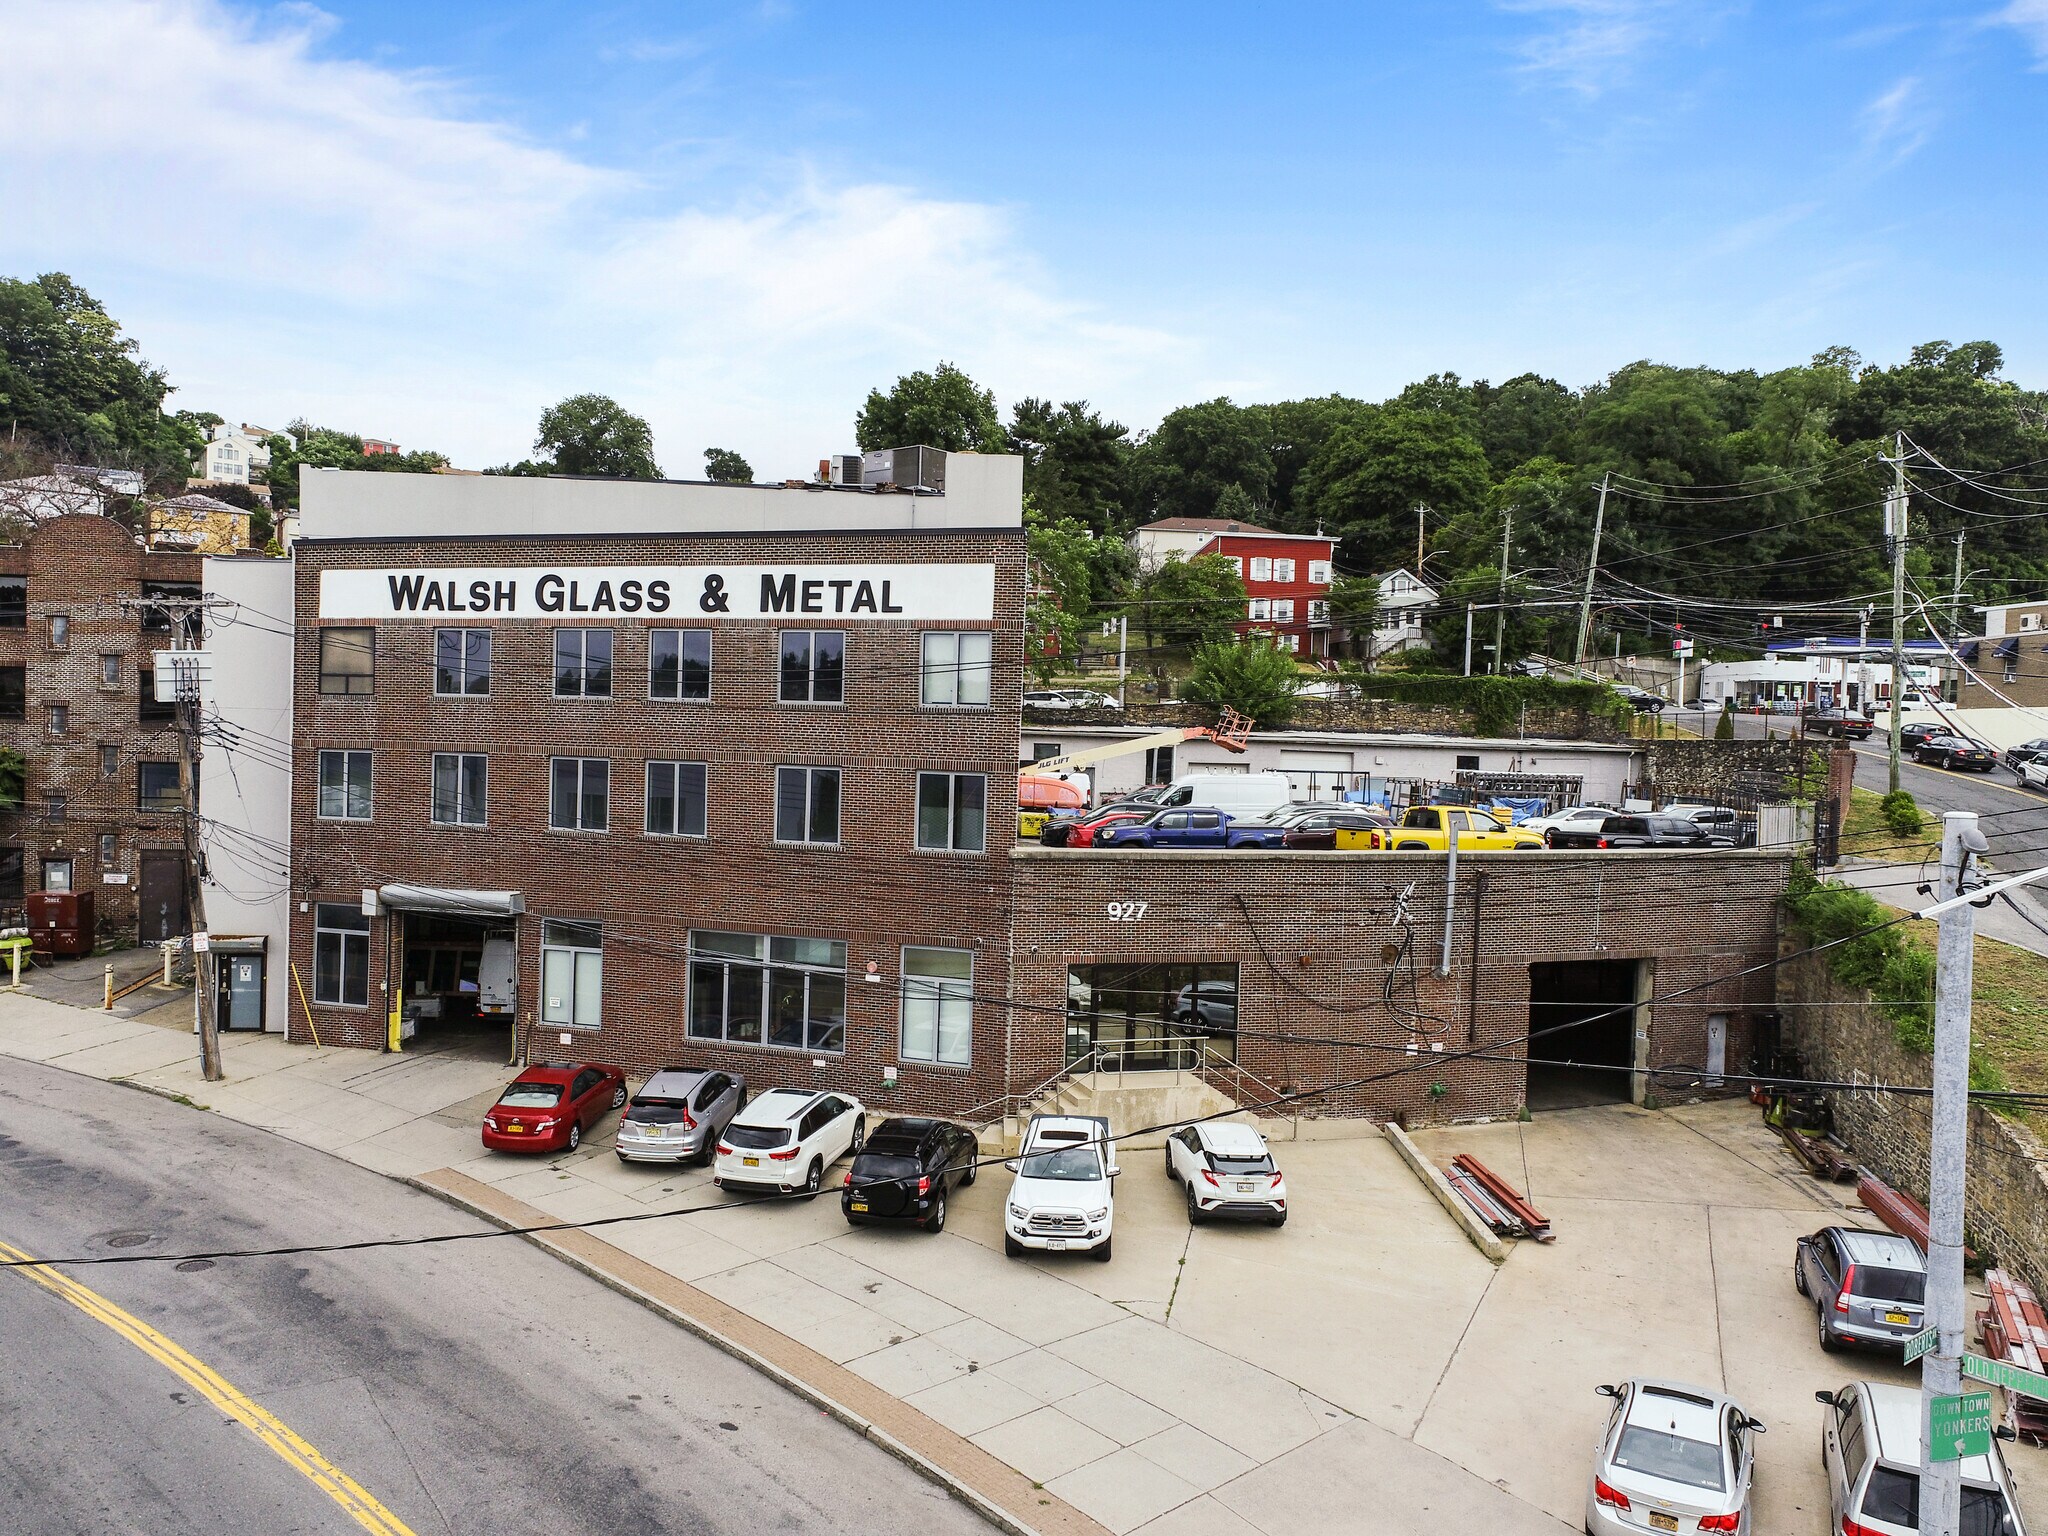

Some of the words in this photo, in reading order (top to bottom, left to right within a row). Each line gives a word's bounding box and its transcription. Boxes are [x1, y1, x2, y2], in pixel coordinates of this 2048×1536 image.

[388, 575, 516, 611] WALSH
[535, 574, 670, 612] GLASS
[700, 574, 730, 612] &
[760, 574, 903, 613] METAL
[1038, 761, 1051, 769] JLG
[1054, 757, 1070, 765] LIFT
[1108, 902, 1148, 920] 927
[1905, 1330, 1933, 1360] ROBERTS
[1967, 1356, 1989, 1379] OLD
[1934, 1416, 1989, 1437] YONKERS
